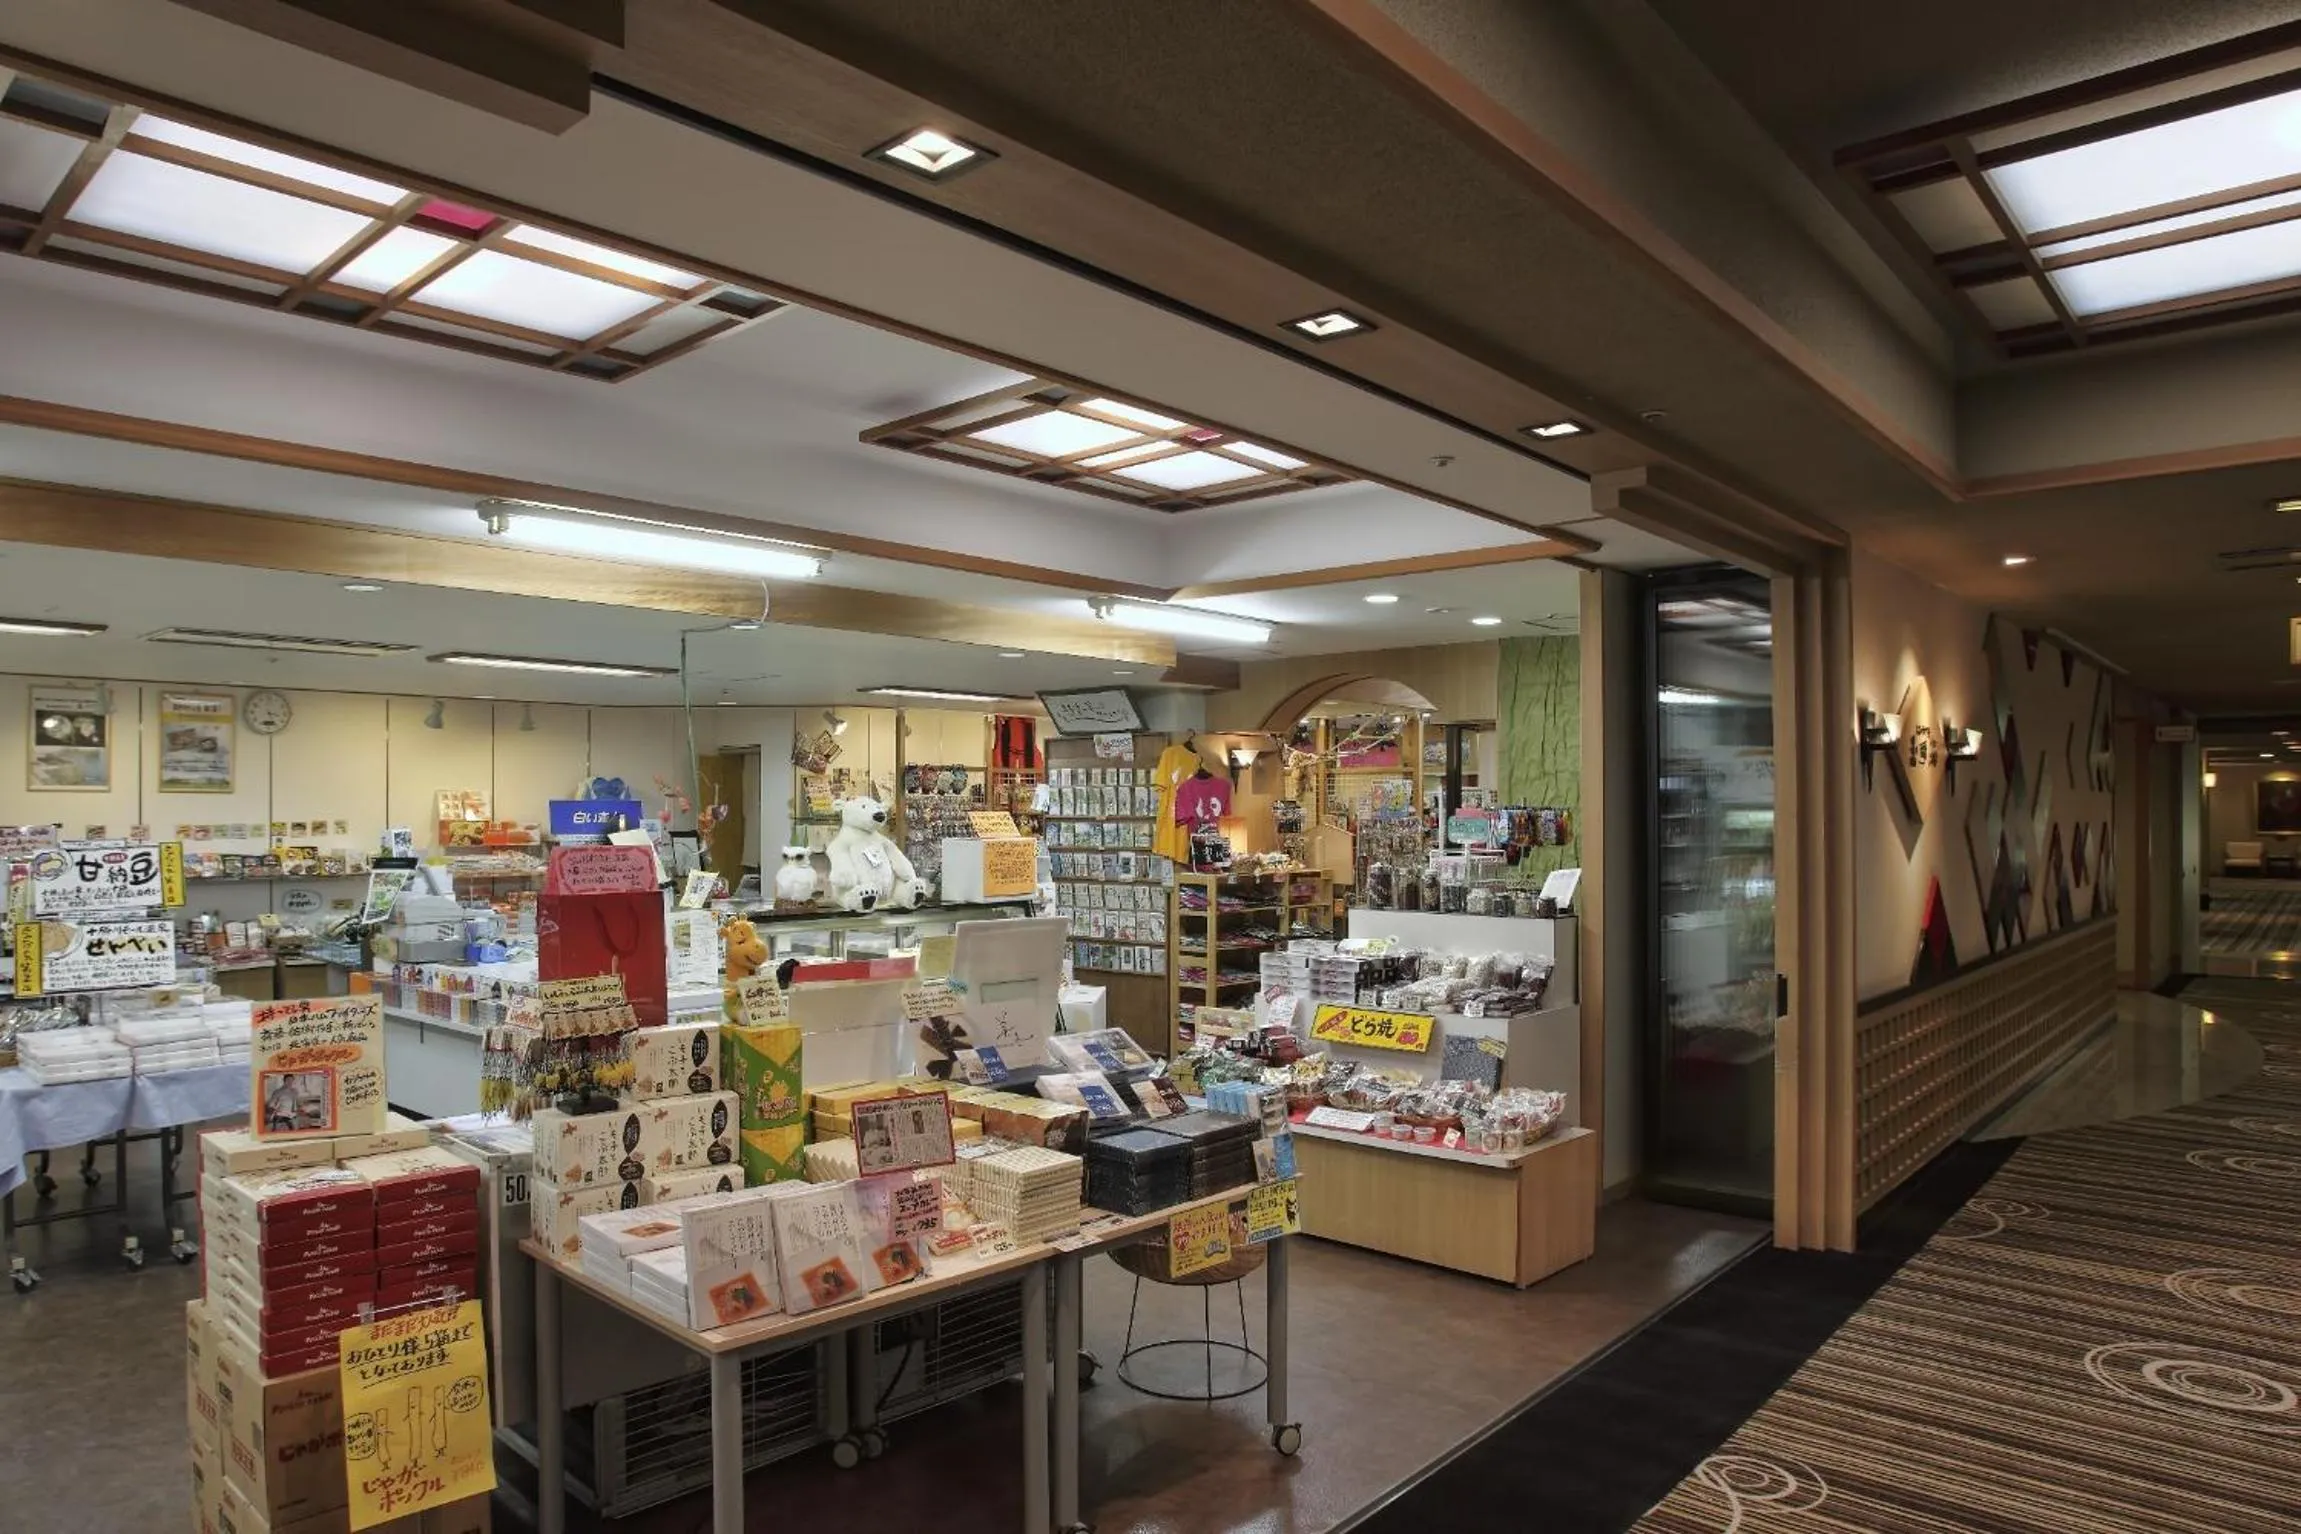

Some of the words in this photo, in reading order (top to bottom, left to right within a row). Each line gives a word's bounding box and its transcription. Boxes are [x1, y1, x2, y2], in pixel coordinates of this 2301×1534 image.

[86, 938, 168, 956] せんべい
[1352, 1016, 1399, 1039] どら焼
[362, 1463, 427, 1494] じゃが
